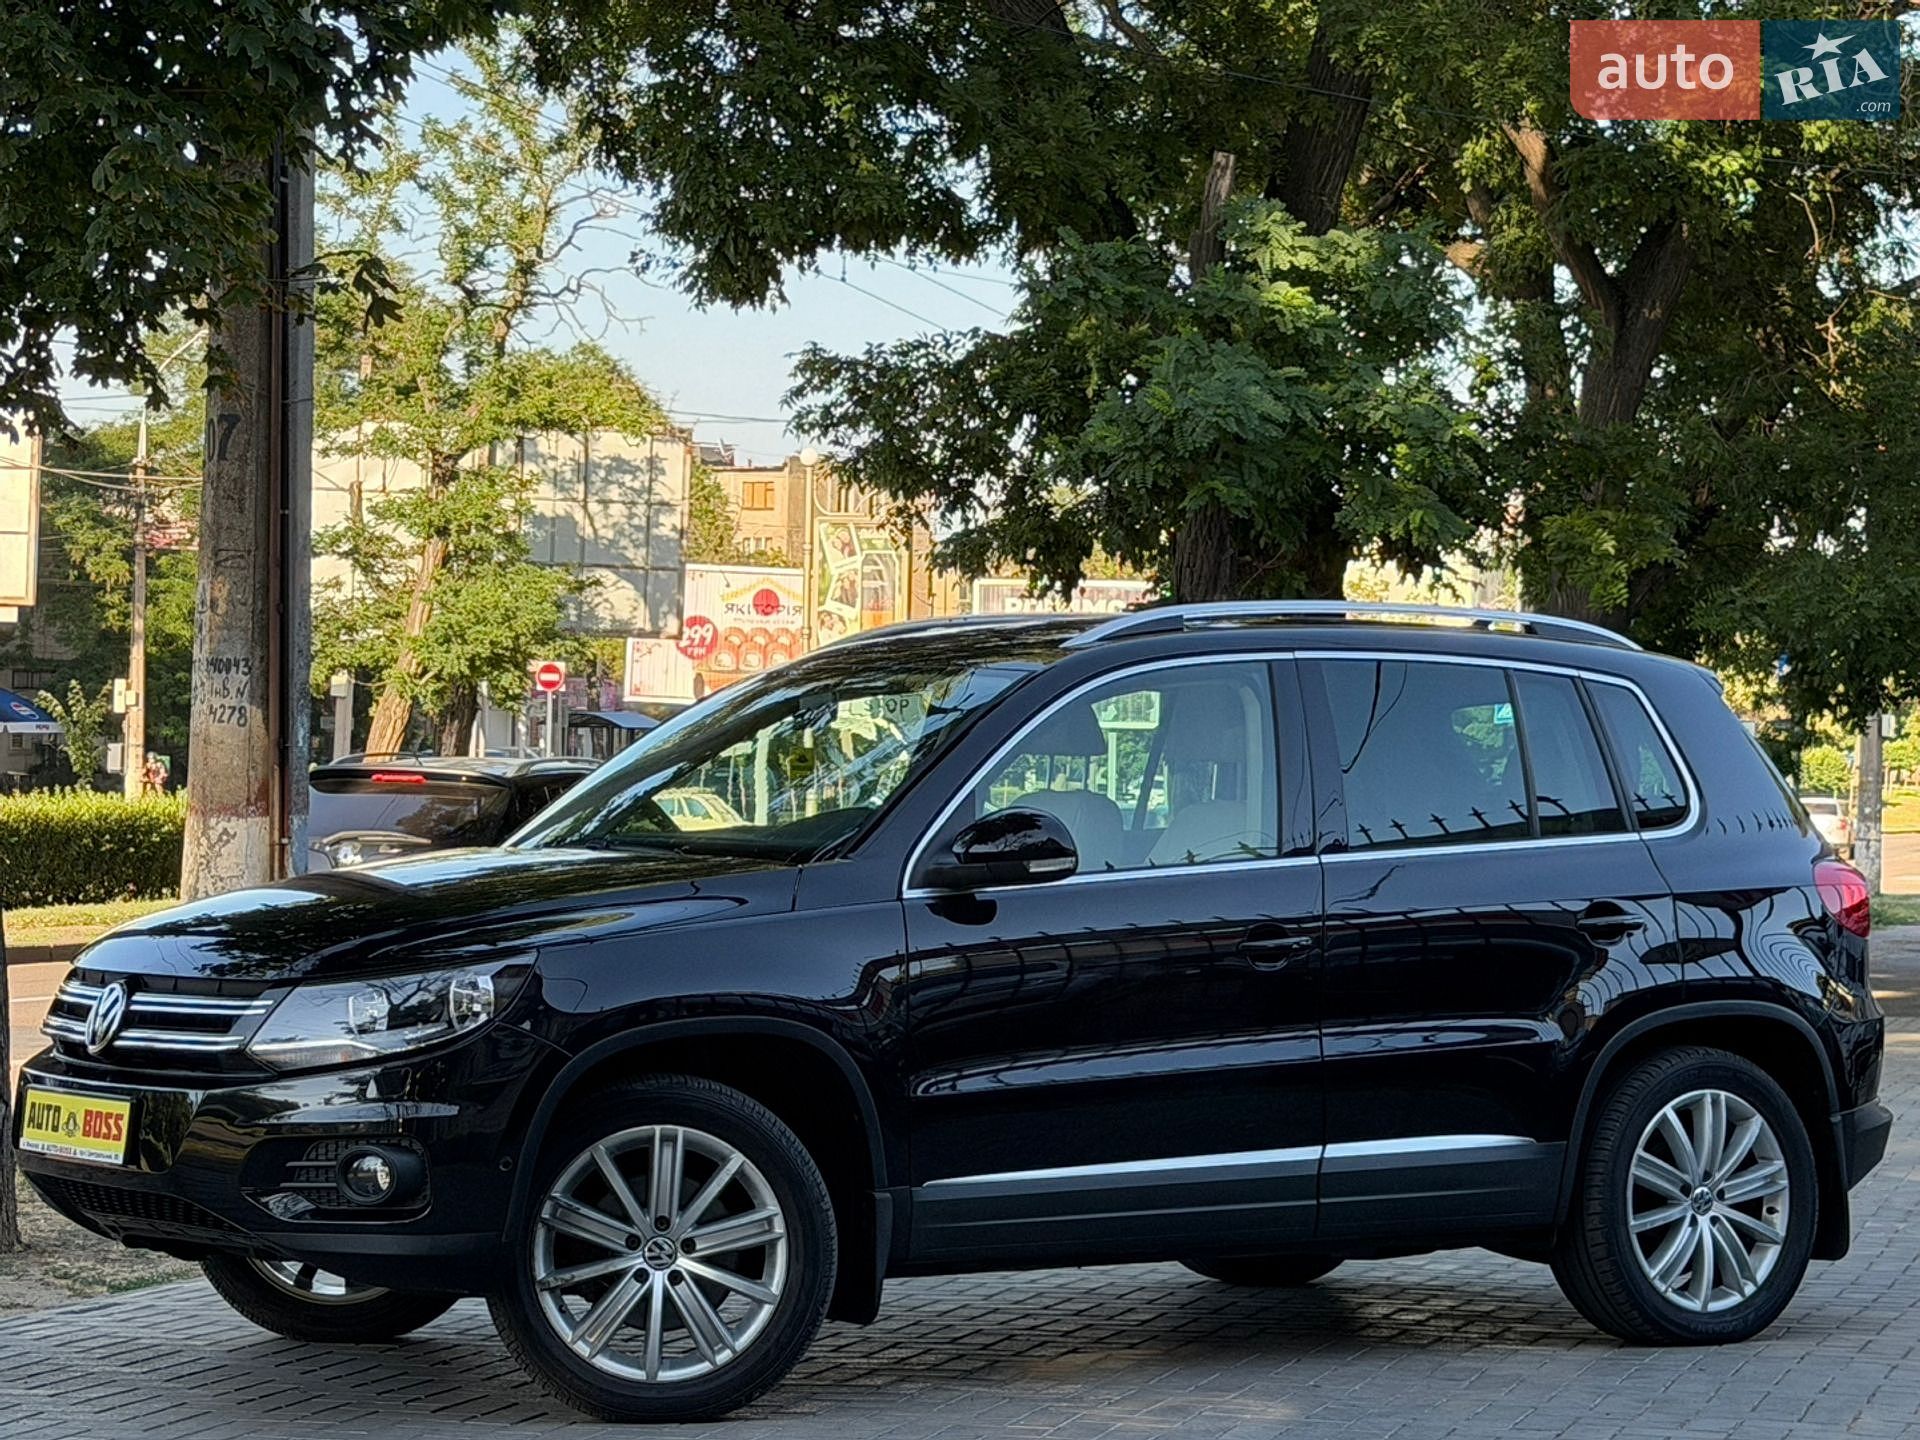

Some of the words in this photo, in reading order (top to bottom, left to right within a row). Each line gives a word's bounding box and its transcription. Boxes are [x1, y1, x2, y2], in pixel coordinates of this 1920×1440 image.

[209, 704, 248, 728] 4278
[27, 1101, 62, 1133] AUTO
[82, 1109, 125, 1142] BOSS
